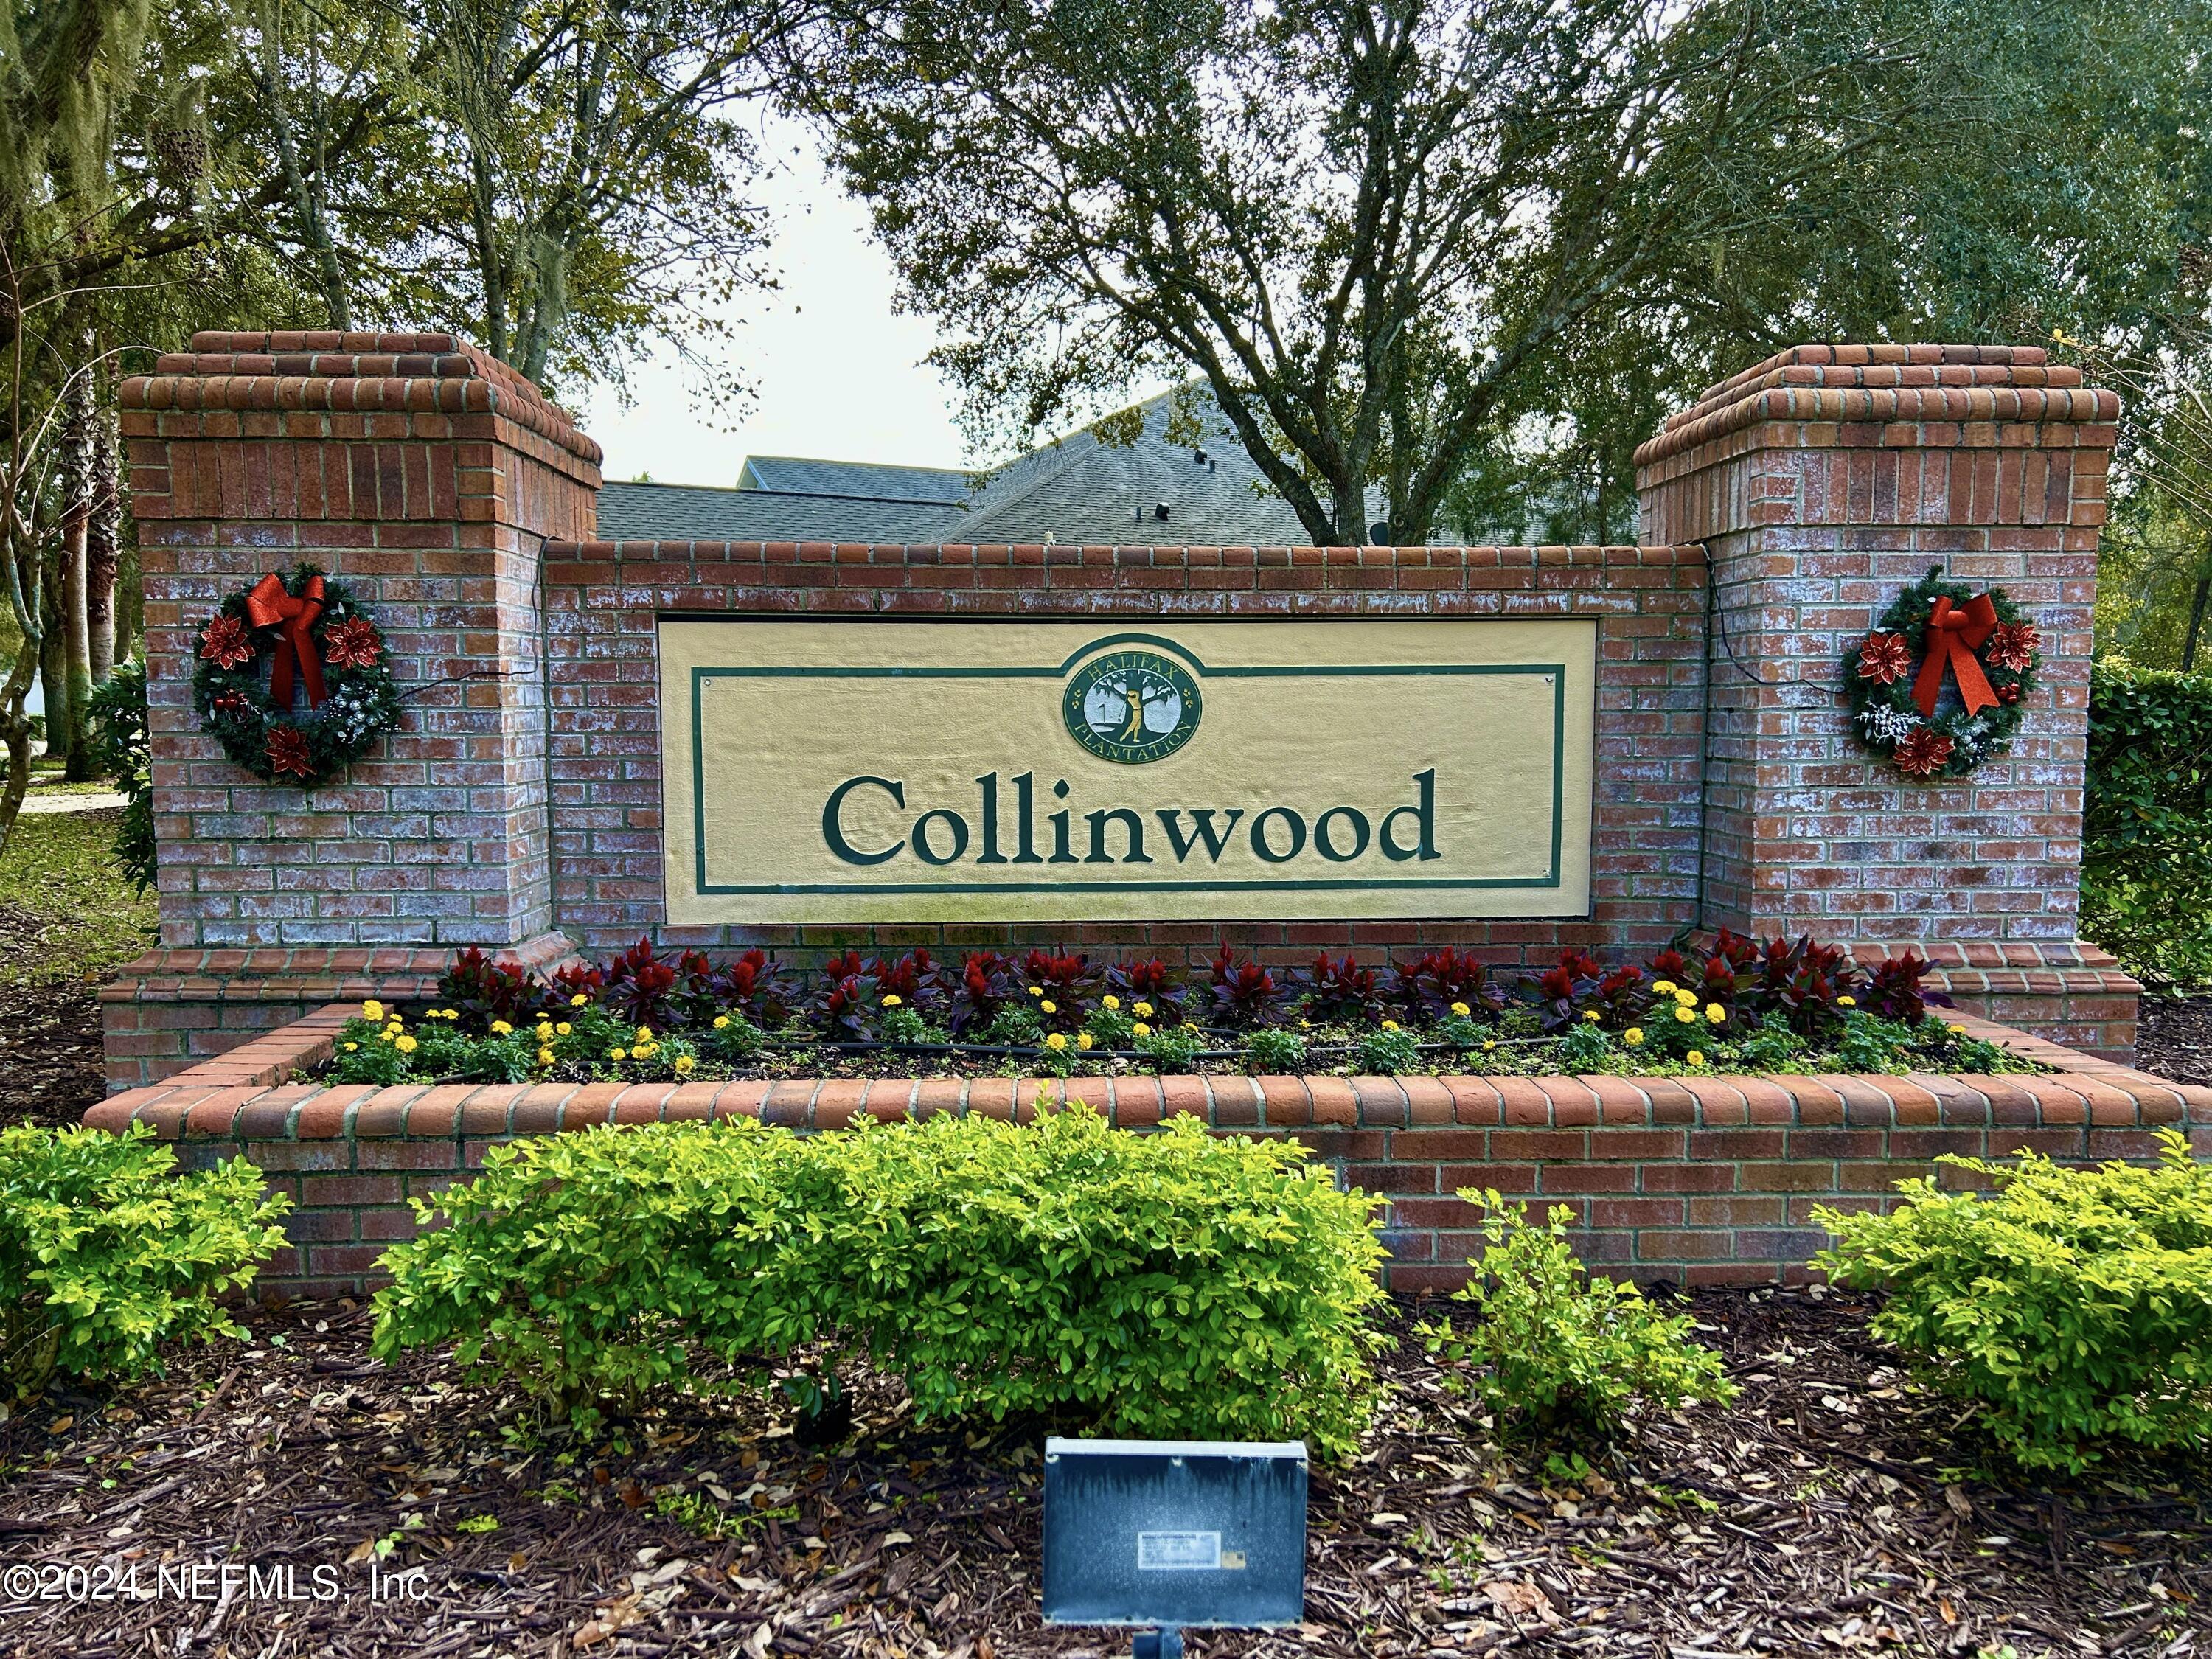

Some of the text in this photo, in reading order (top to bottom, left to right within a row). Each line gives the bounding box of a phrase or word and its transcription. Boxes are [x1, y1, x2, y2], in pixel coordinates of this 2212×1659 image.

[1087, 655, 1179, 681] HALIFAX
[1074, 720, 1192, 761] PLANTATION
[821, 767, 1442, 865] Collinwood
